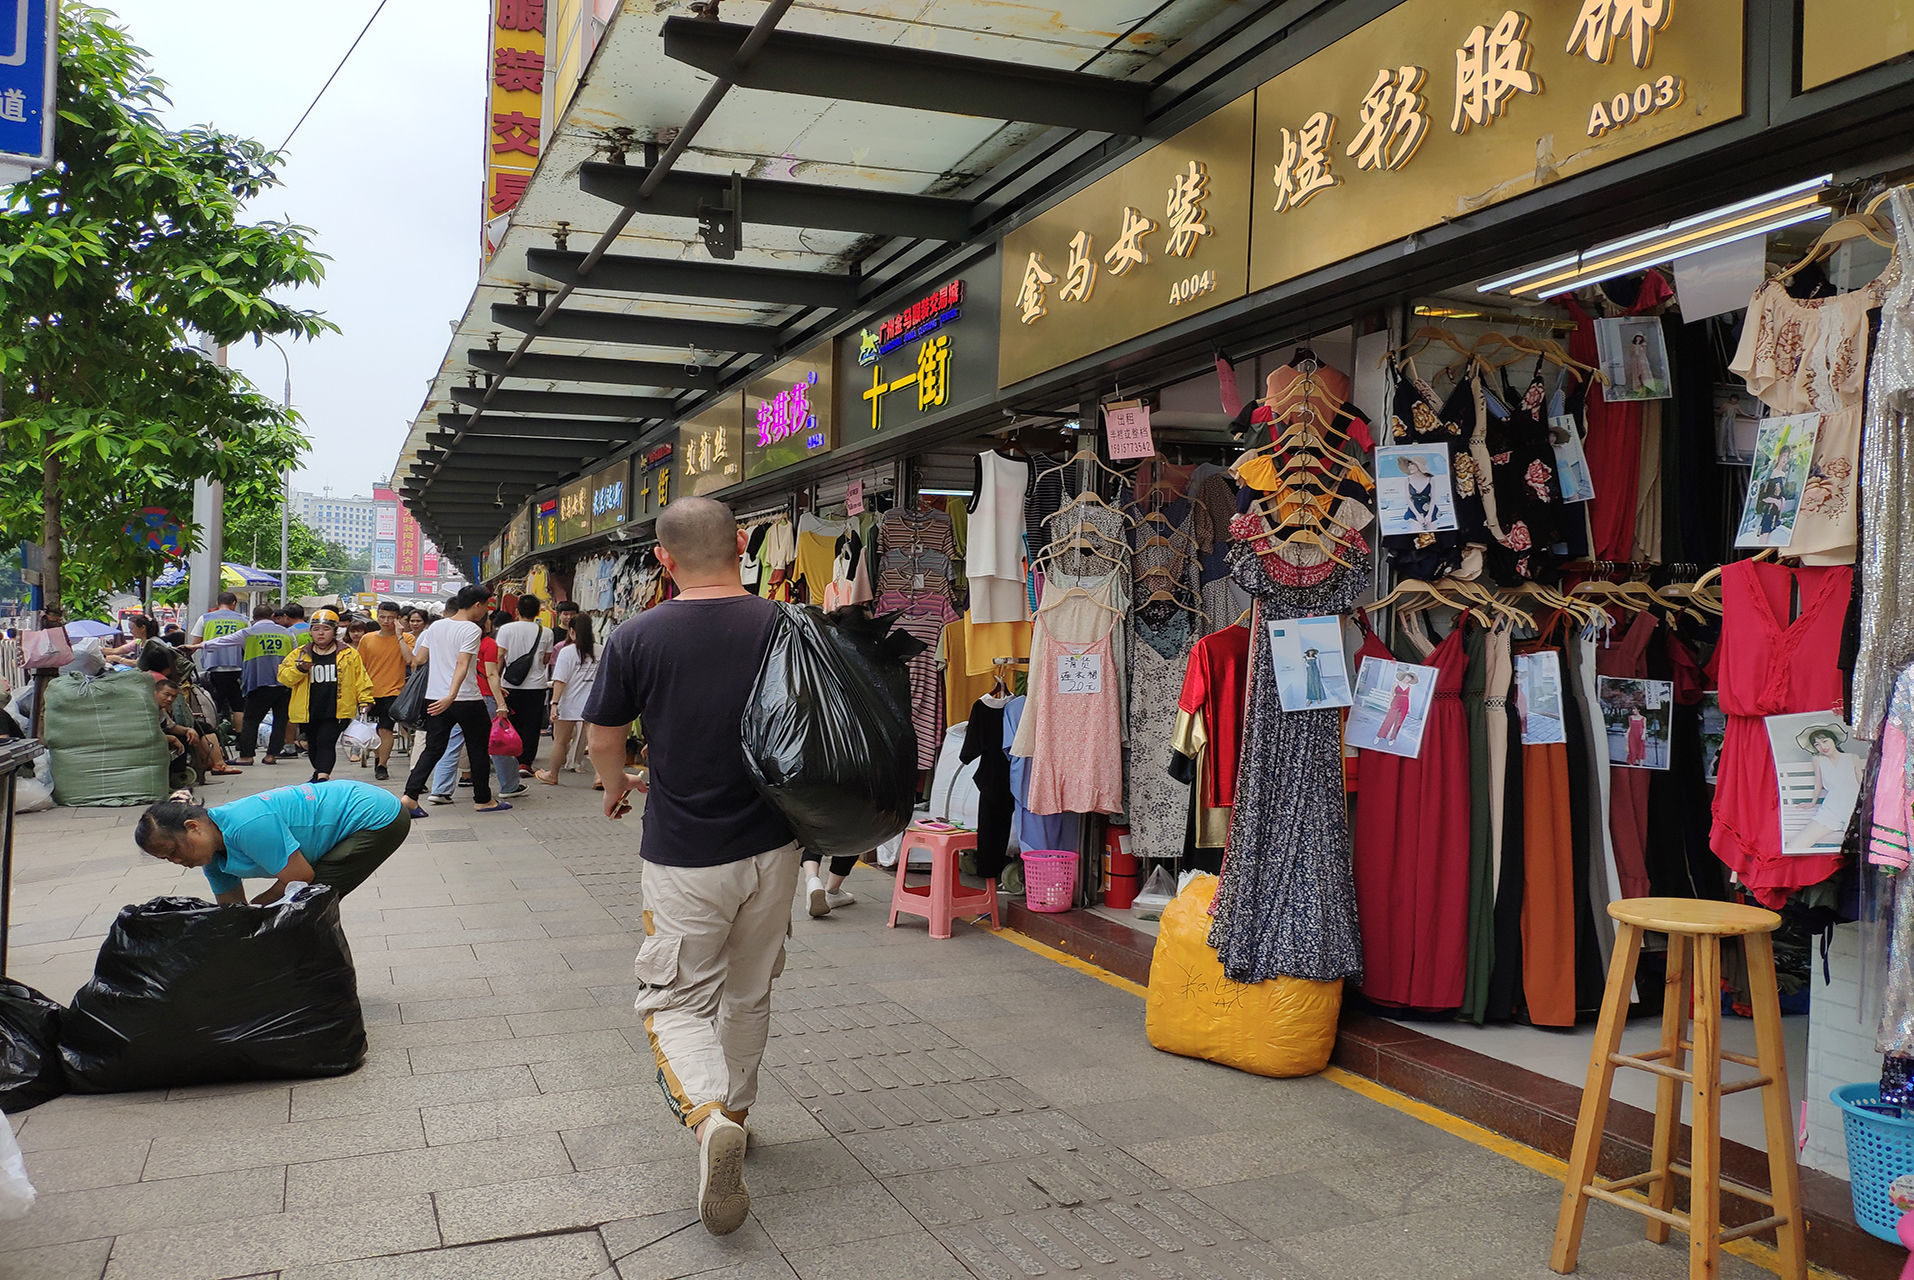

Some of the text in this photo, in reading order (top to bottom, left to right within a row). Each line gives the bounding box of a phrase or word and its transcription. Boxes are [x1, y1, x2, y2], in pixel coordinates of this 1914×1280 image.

[1587, 75, 1684, 137] A003
[1016, 160, 1214, 326] 金马女装
[1169, 270, 1216, 306] A004
[863, 335, 952, 430] 十一街
[1117, 412, 1135, 426] 出租
[215, 624, 237, 635] 275
[259, 639, 282, 650] 129
[1068, 680, 1097, 692] 20元
